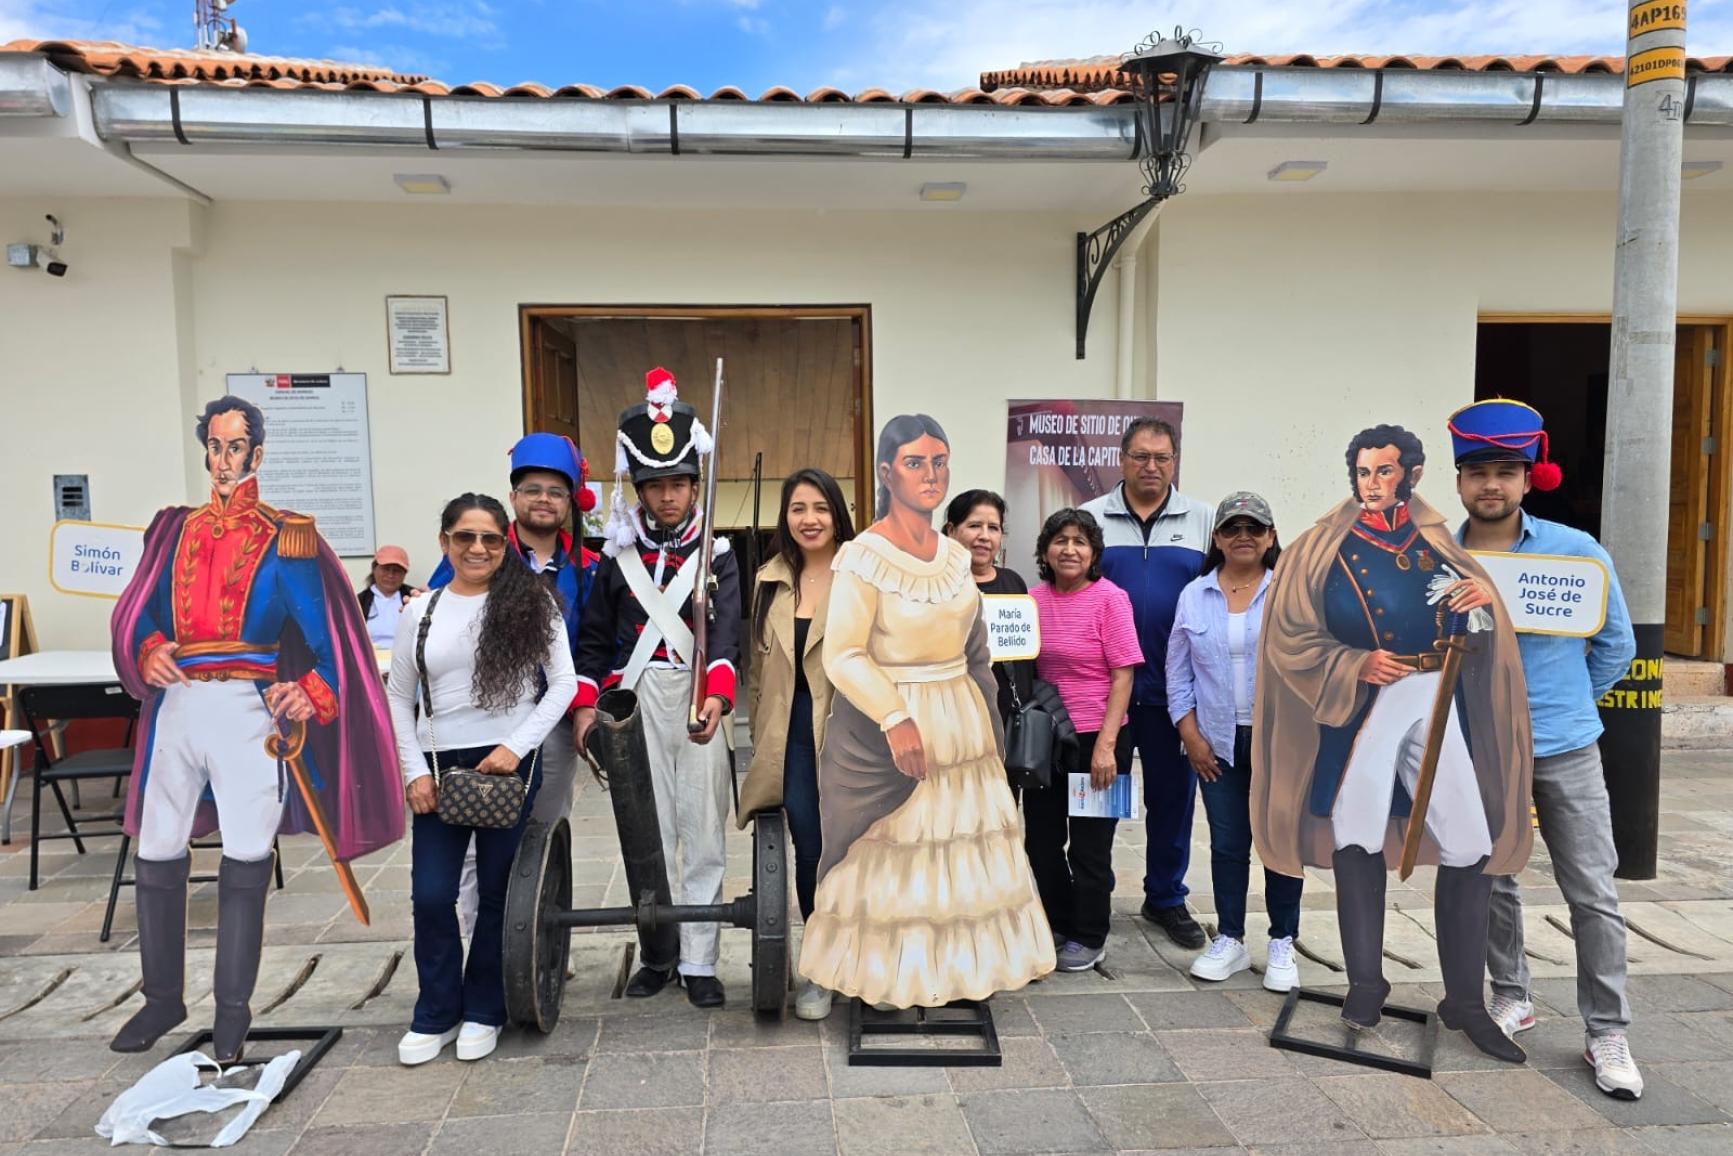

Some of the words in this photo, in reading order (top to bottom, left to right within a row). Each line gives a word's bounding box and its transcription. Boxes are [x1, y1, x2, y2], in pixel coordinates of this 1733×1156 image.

[1029, 415, 1064, 435] MUSEO
[1065, 415, 1078, 435] DE
[1080, 415, 1106, 435] SITIO
[1107, 415, 1121, 436] DE
[1029, 445, 1055, 466] CASA
[1057, 446, 1071, 466] DE
[1073, 446, 1086, 466] LA
[74, 544, 120, 560] Simón
[1518, 572, 1586, 588] Antonio
[1519, 588, 1557, 601] José
[1561, 590, 1582, 603] de
[998, 608, 1022, 619] María
[1525, 602, 1573, 617] Sucre
[990, 622, 1020, 633] Parado
[1021, 622, 1031, 632] de
[998, 635, 1026, 647] Bellido
[1623, 658, 1664, 680] ON
[1597, 689, 1664, 709] STRIN
